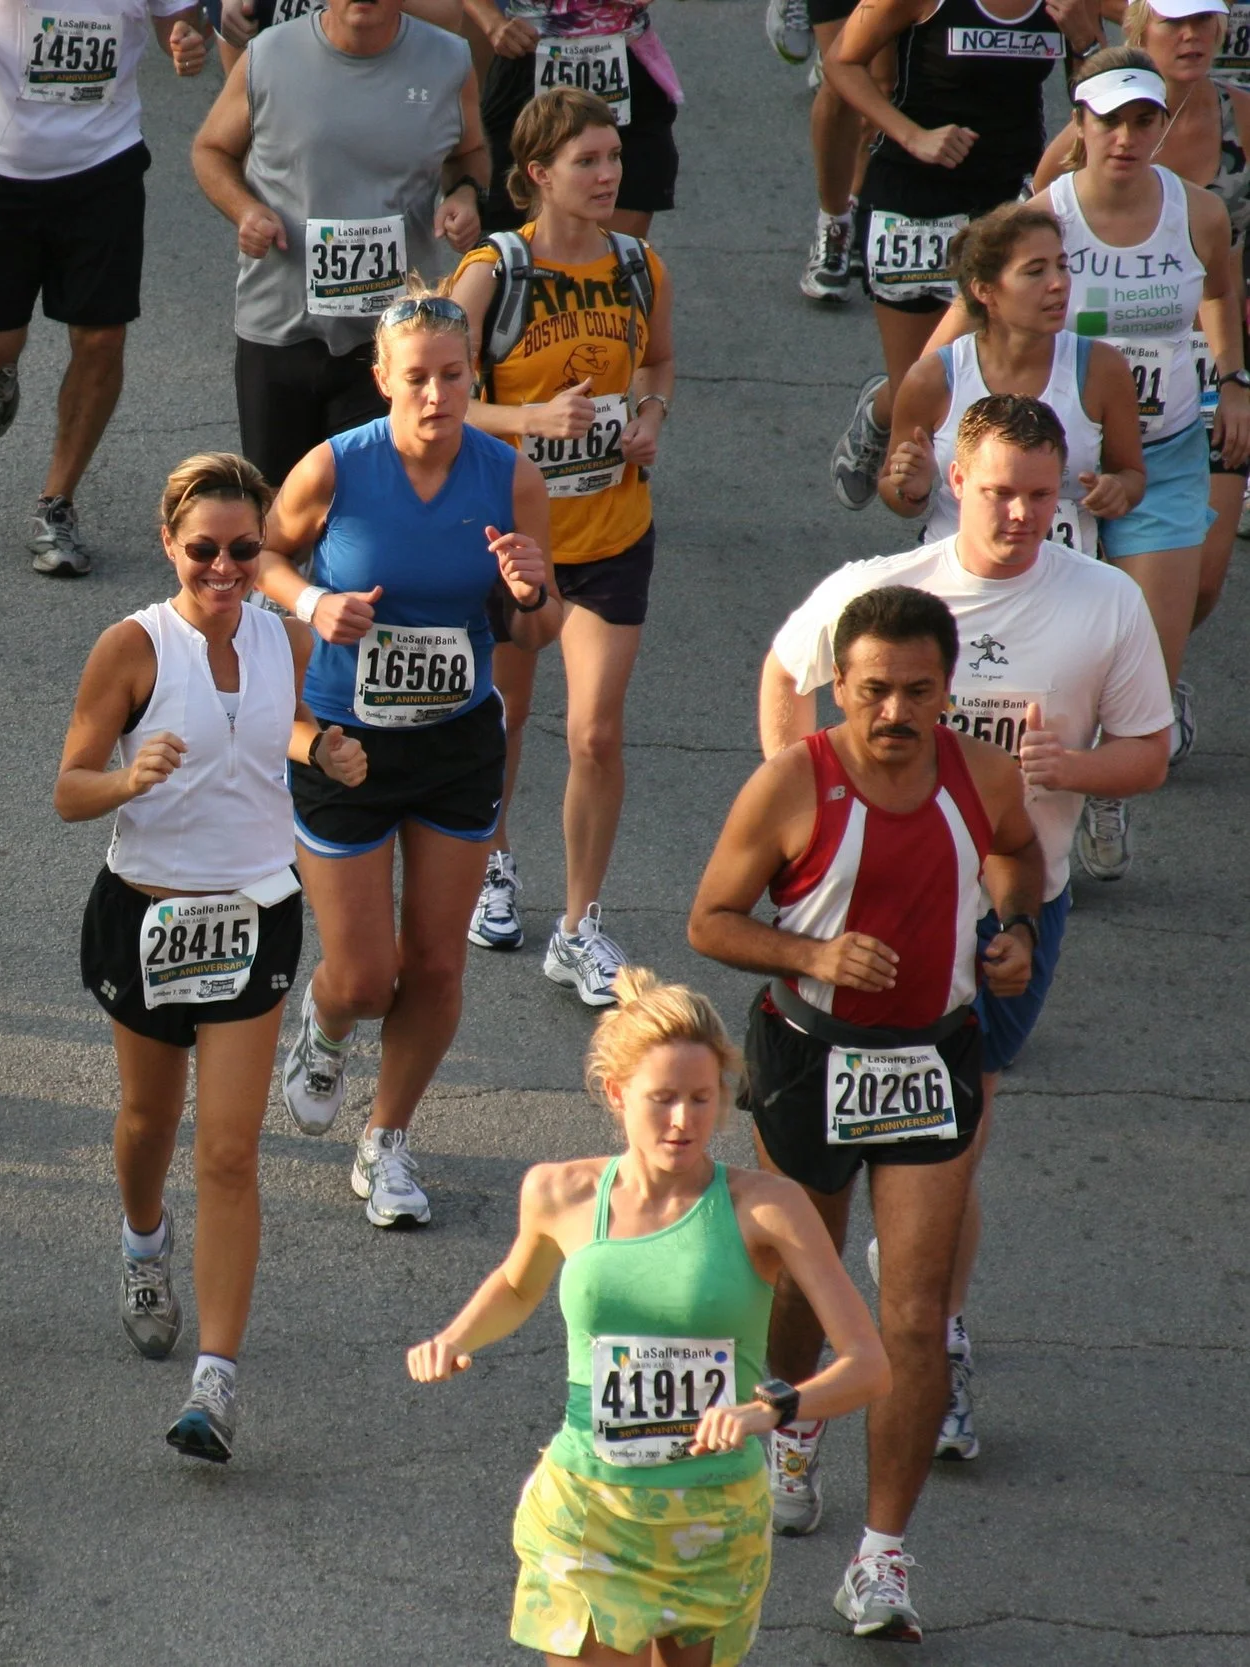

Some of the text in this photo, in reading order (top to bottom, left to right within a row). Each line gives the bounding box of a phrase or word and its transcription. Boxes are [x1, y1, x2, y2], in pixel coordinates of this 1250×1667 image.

[59, 19, 111, 31] LaSalle Bank
[594, 43, 612, 54] Bank
[961, 31, 1049, 51] NOELIA
[31, 33, 116, 71] 14536
[540, 57, 623, 92] 45034
[338, 225, 392, 237] LaSalle Bank
[932, 218, 953, 228] Bank
[312, 241, 399, 281] 35731
[875, 234, 953, 269] 1513
[1069, 247, 1183, 280] JULIA
[342, 278, 404, 294] ANNIVERSARY
[1114, 284, 1180, 304] healthy
[1114, 303, 1183, 321] schools
[524, 310, 646, 358] BOSTON COLLEE
[1113, 318, 1184, 337] campaign
[1139, 348, 1159, 358] Bank
[1192, 340, 1209, 349] Ban
[397, 634, 457, 645] LaSalle Bank
[365, 648, 467, 692] 16568
[374, 695, 463, 703] 30th ANNIVERSARY
[961, 697, 1028, 710] LaSalle Bank
[178, 904, 241, 916] LaSalle Bank
[146, 919, 250, 965] 28415
[158, 960, 246, 981] 30th ANNIVERSARY
[868, 1056, 906, 1064] LaSalle
[835, 1069, 944, 1116] 20266
[850, 1113, 946, 1136] 30th ANNIVERSARY
[637, 1347, 712, 1359] LaSalle Bank
[602, 1369, 726, 1419] 41912
